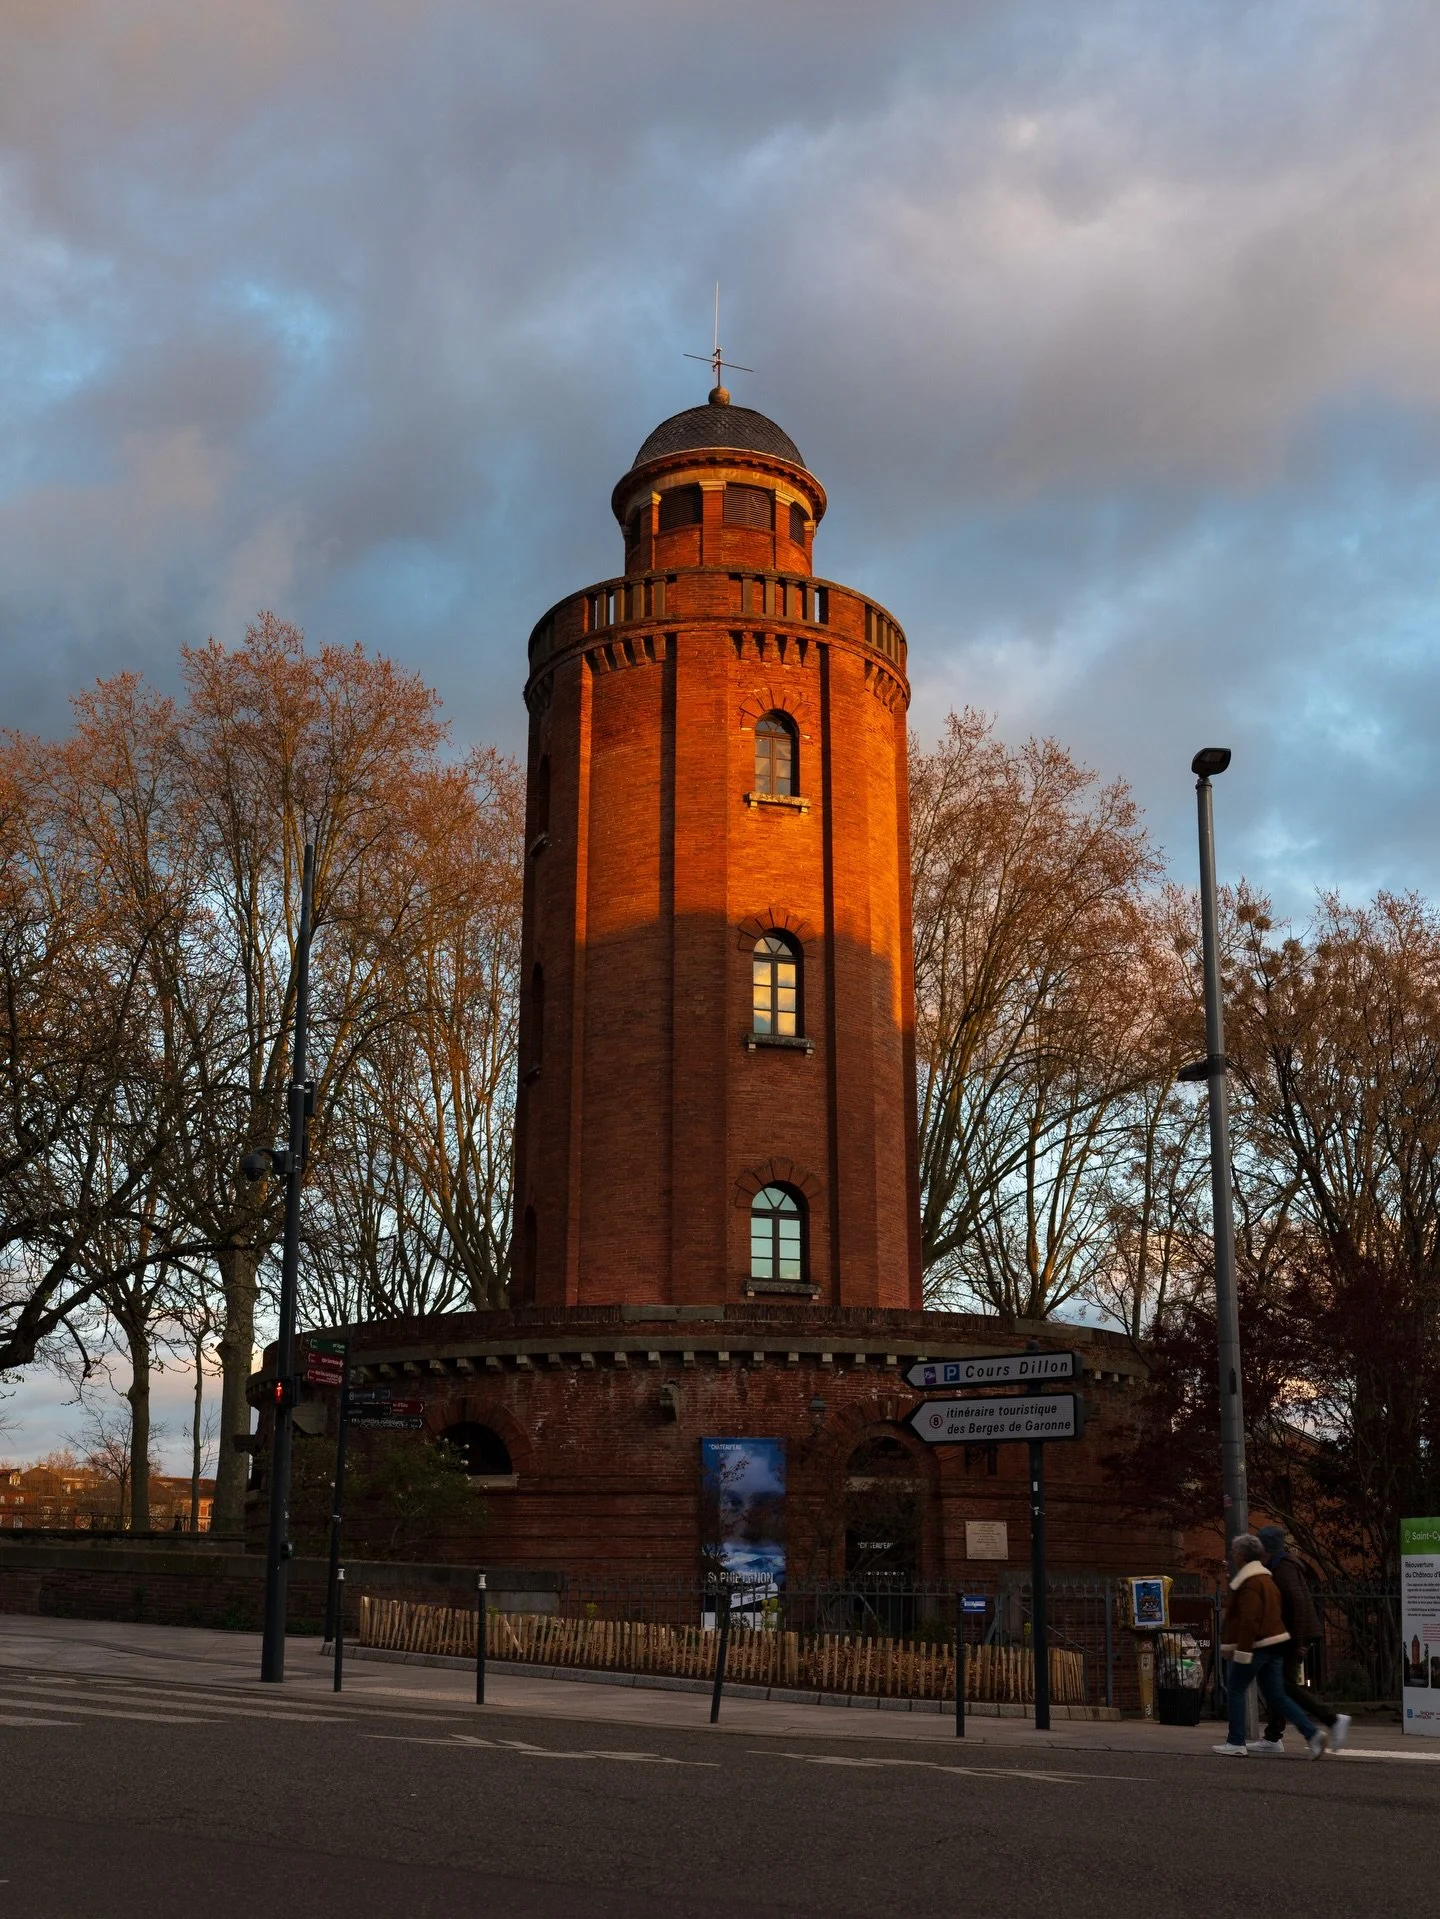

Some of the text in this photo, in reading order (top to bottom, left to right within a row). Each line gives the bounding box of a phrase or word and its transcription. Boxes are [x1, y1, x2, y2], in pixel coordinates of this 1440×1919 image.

[965, 1365, 1010, 1378] Cours
[1019, 1360, 1068, 1375] Dillon
[946, 1403, 1057, 1418] itinéraire touristique
[932, 1417, 939, 1426] 8
[947, 1419, 1071, 1435] des Berges de Garonne
